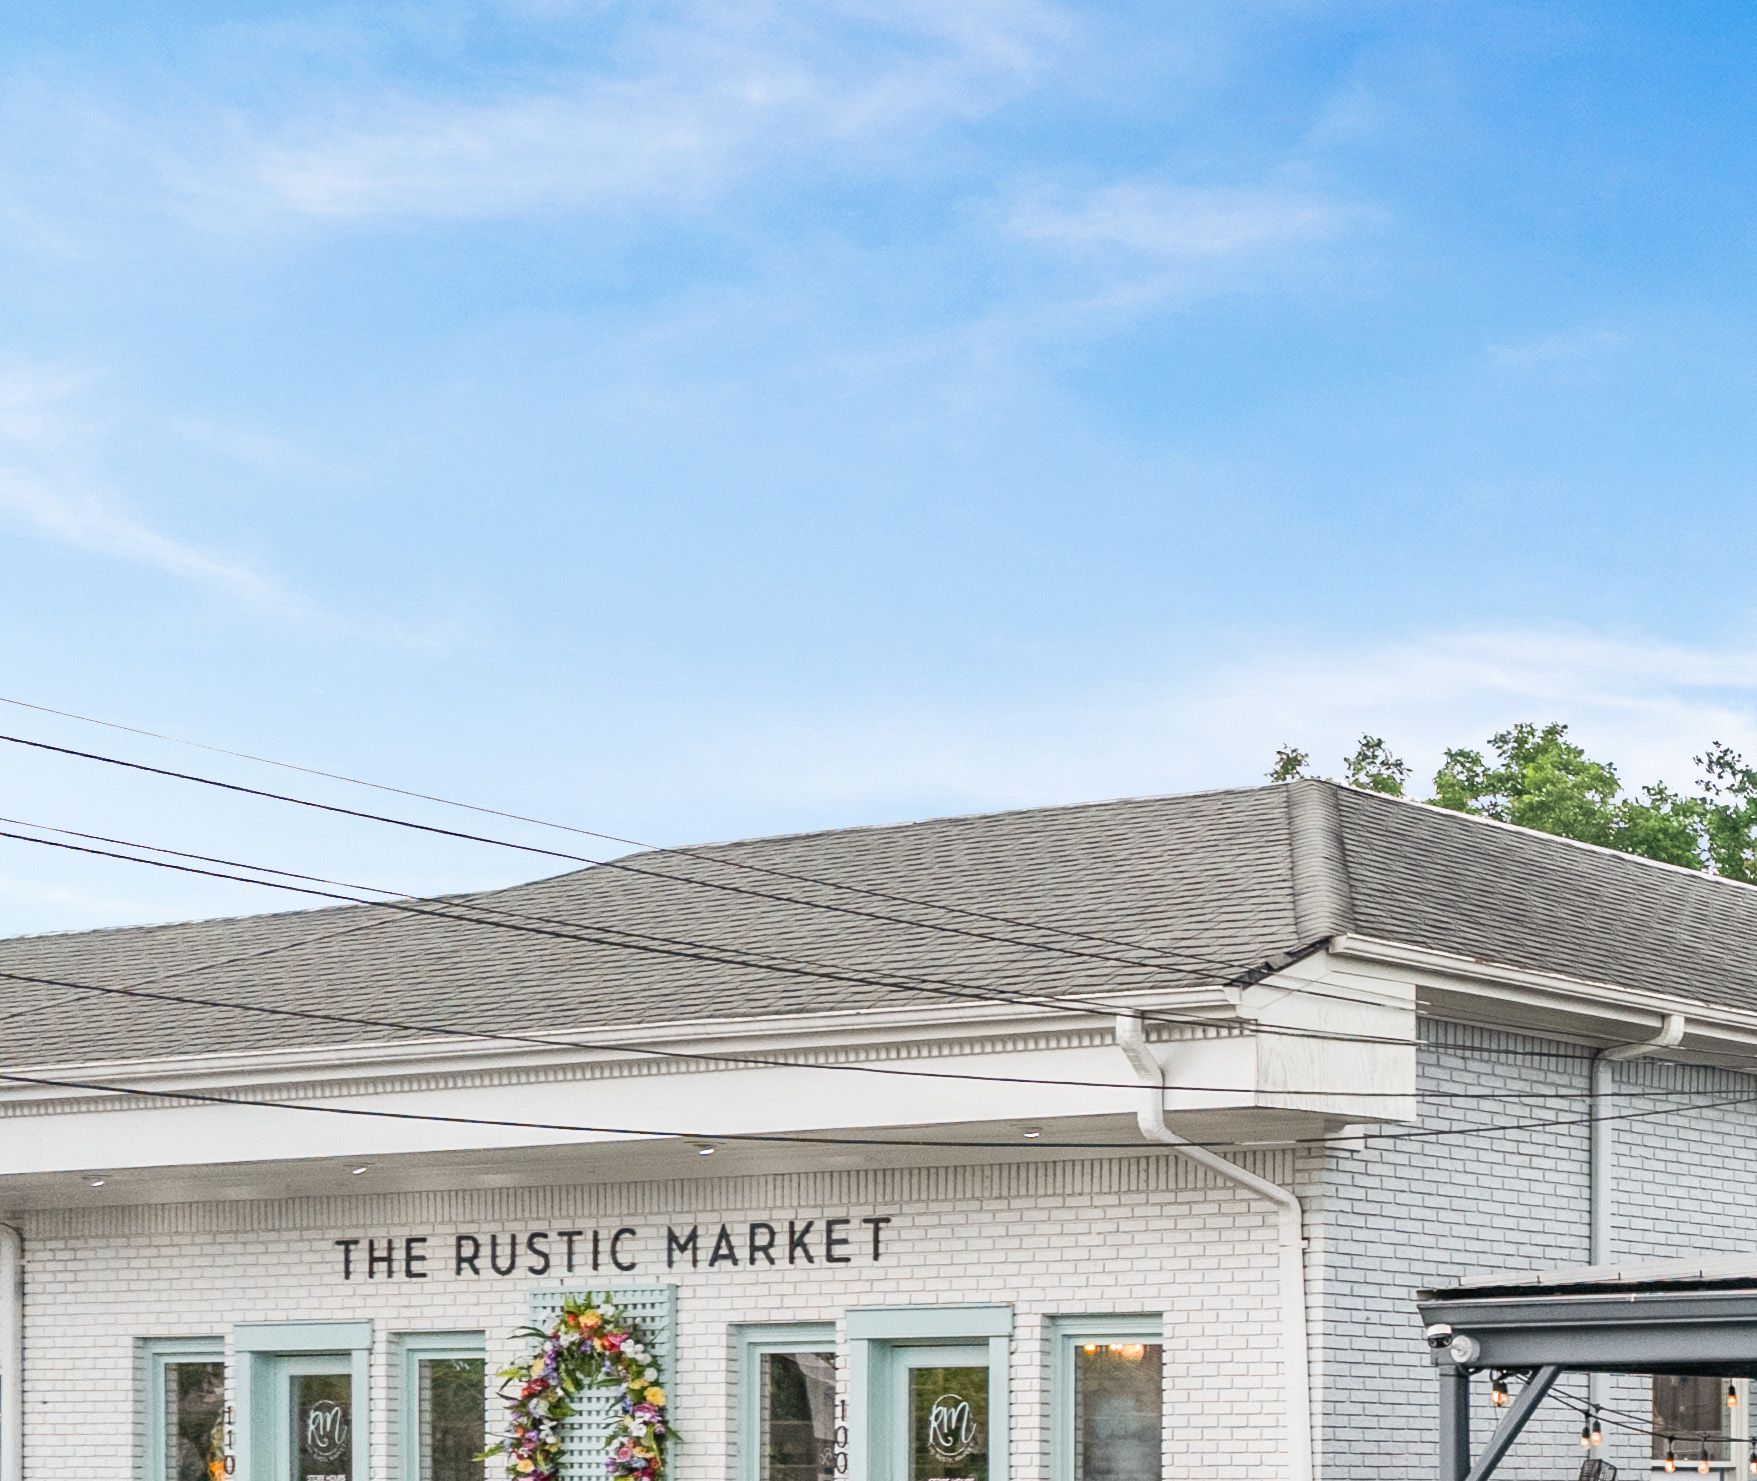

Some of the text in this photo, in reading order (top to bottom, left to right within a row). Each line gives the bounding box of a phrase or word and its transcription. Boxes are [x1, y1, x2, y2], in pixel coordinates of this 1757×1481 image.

[334, 1217, 891, 1280] THE RUSTIC MARKET
